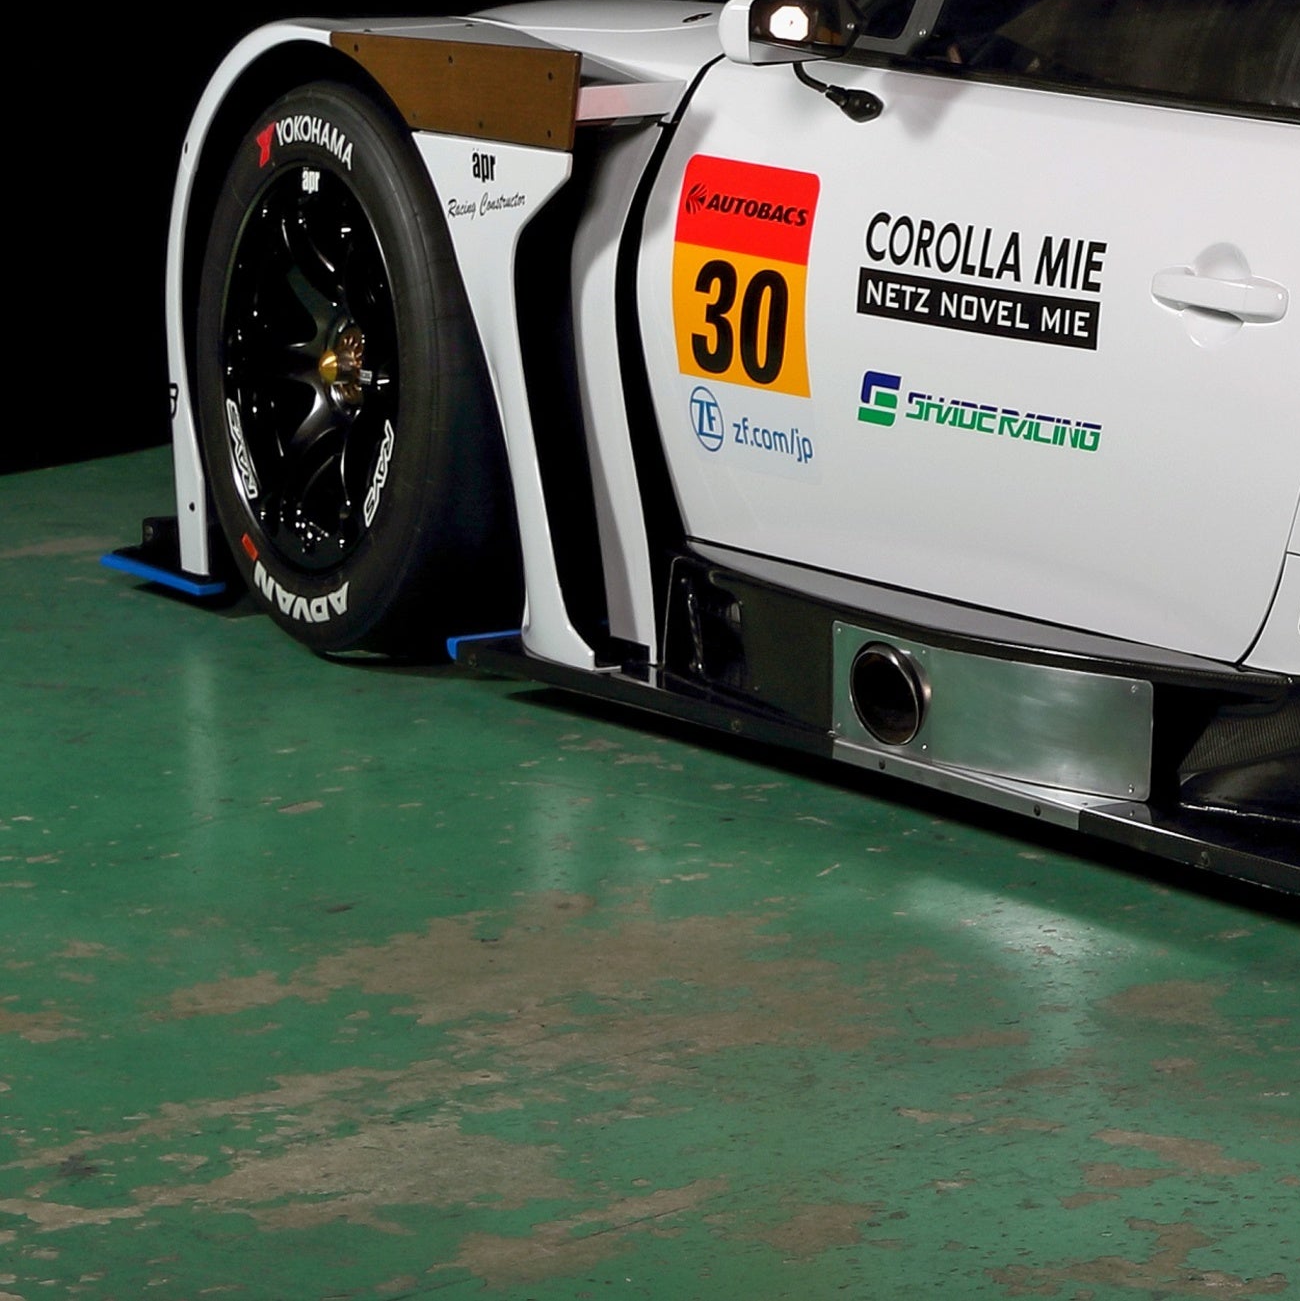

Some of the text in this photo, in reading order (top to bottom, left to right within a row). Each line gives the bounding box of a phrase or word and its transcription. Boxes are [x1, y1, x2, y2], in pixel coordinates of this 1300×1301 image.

[275, 115, 353, 171] YOKOHAMA
[448, 192, 526, 220] Racing Constructor
[707, 194, 809, 227] AUTOBACS
[866, 211, 1108, 293] COROLLA MIE
[692, 259, 788, 385] 30
[866, 279, 1091, 338] NETZ NOVEL MIE
[733, 417, 813, 464] zf.com/jp
[906, 391, 1103, 452] SHADE RACING
[254, 559, 350, 623] ADVAN
